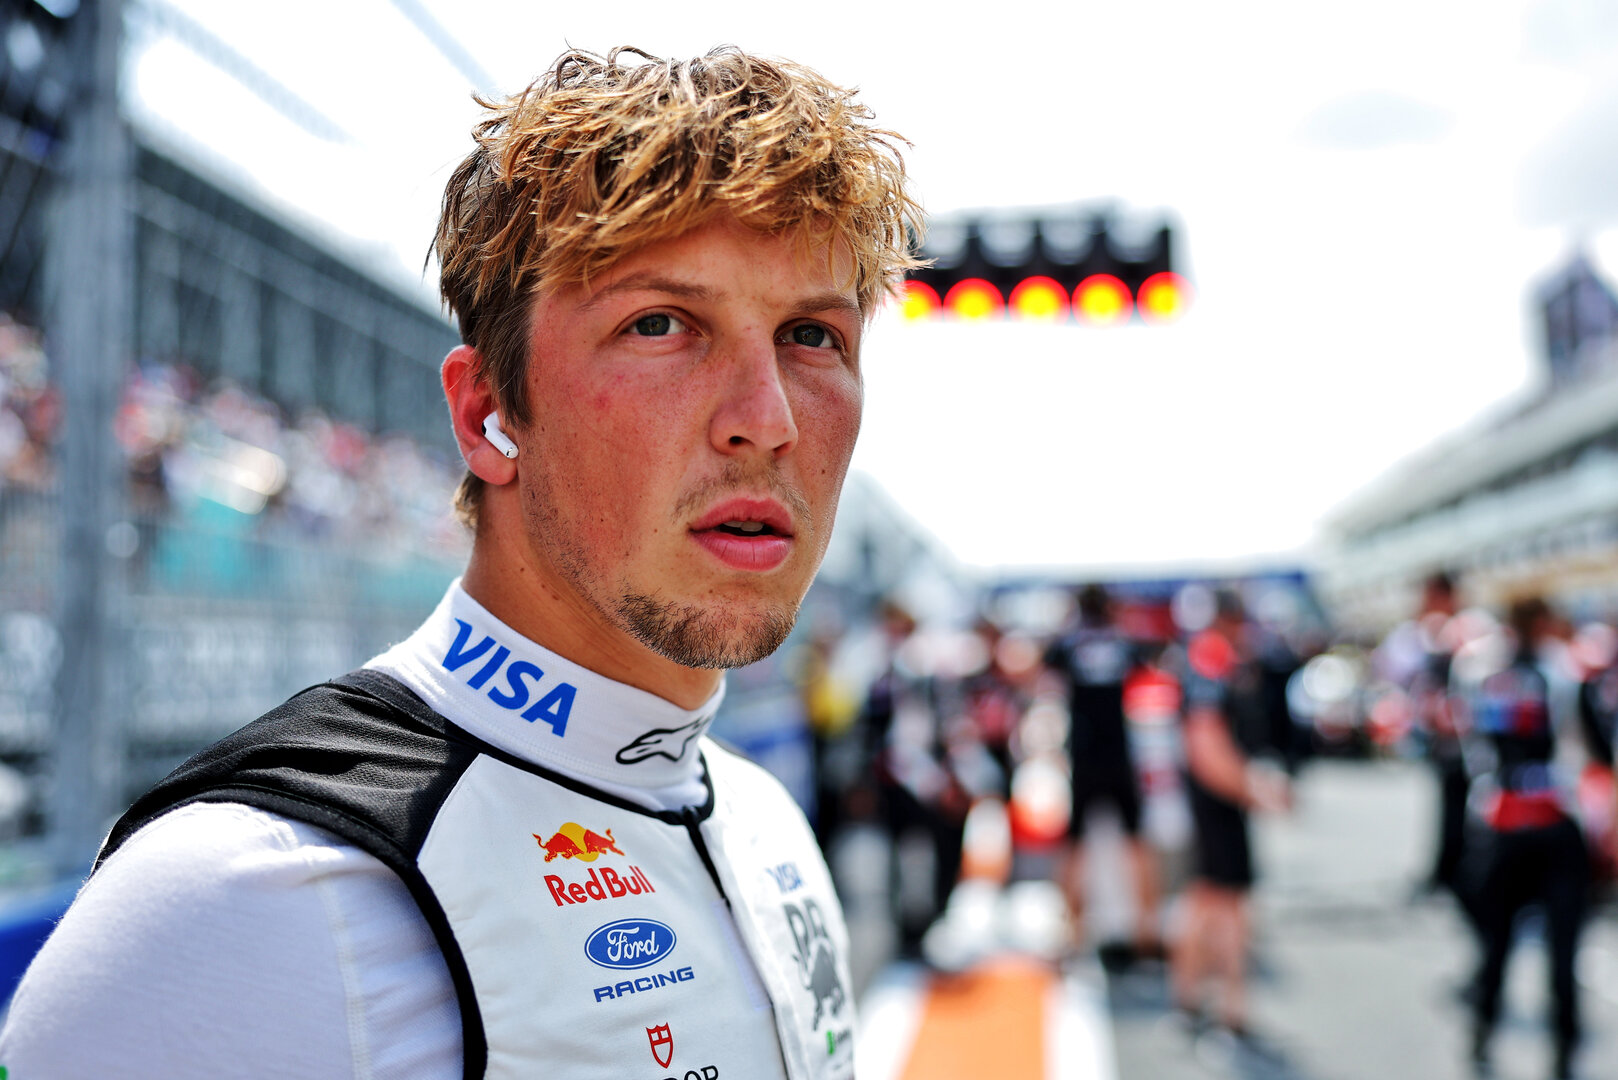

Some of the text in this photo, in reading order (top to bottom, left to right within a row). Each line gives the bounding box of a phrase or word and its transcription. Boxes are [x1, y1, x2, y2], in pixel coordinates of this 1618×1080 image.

[442, 617, 577, 738] VISA
[607, 926, 659, 962] Ford
[593, 966, 695, 1003] RACING
